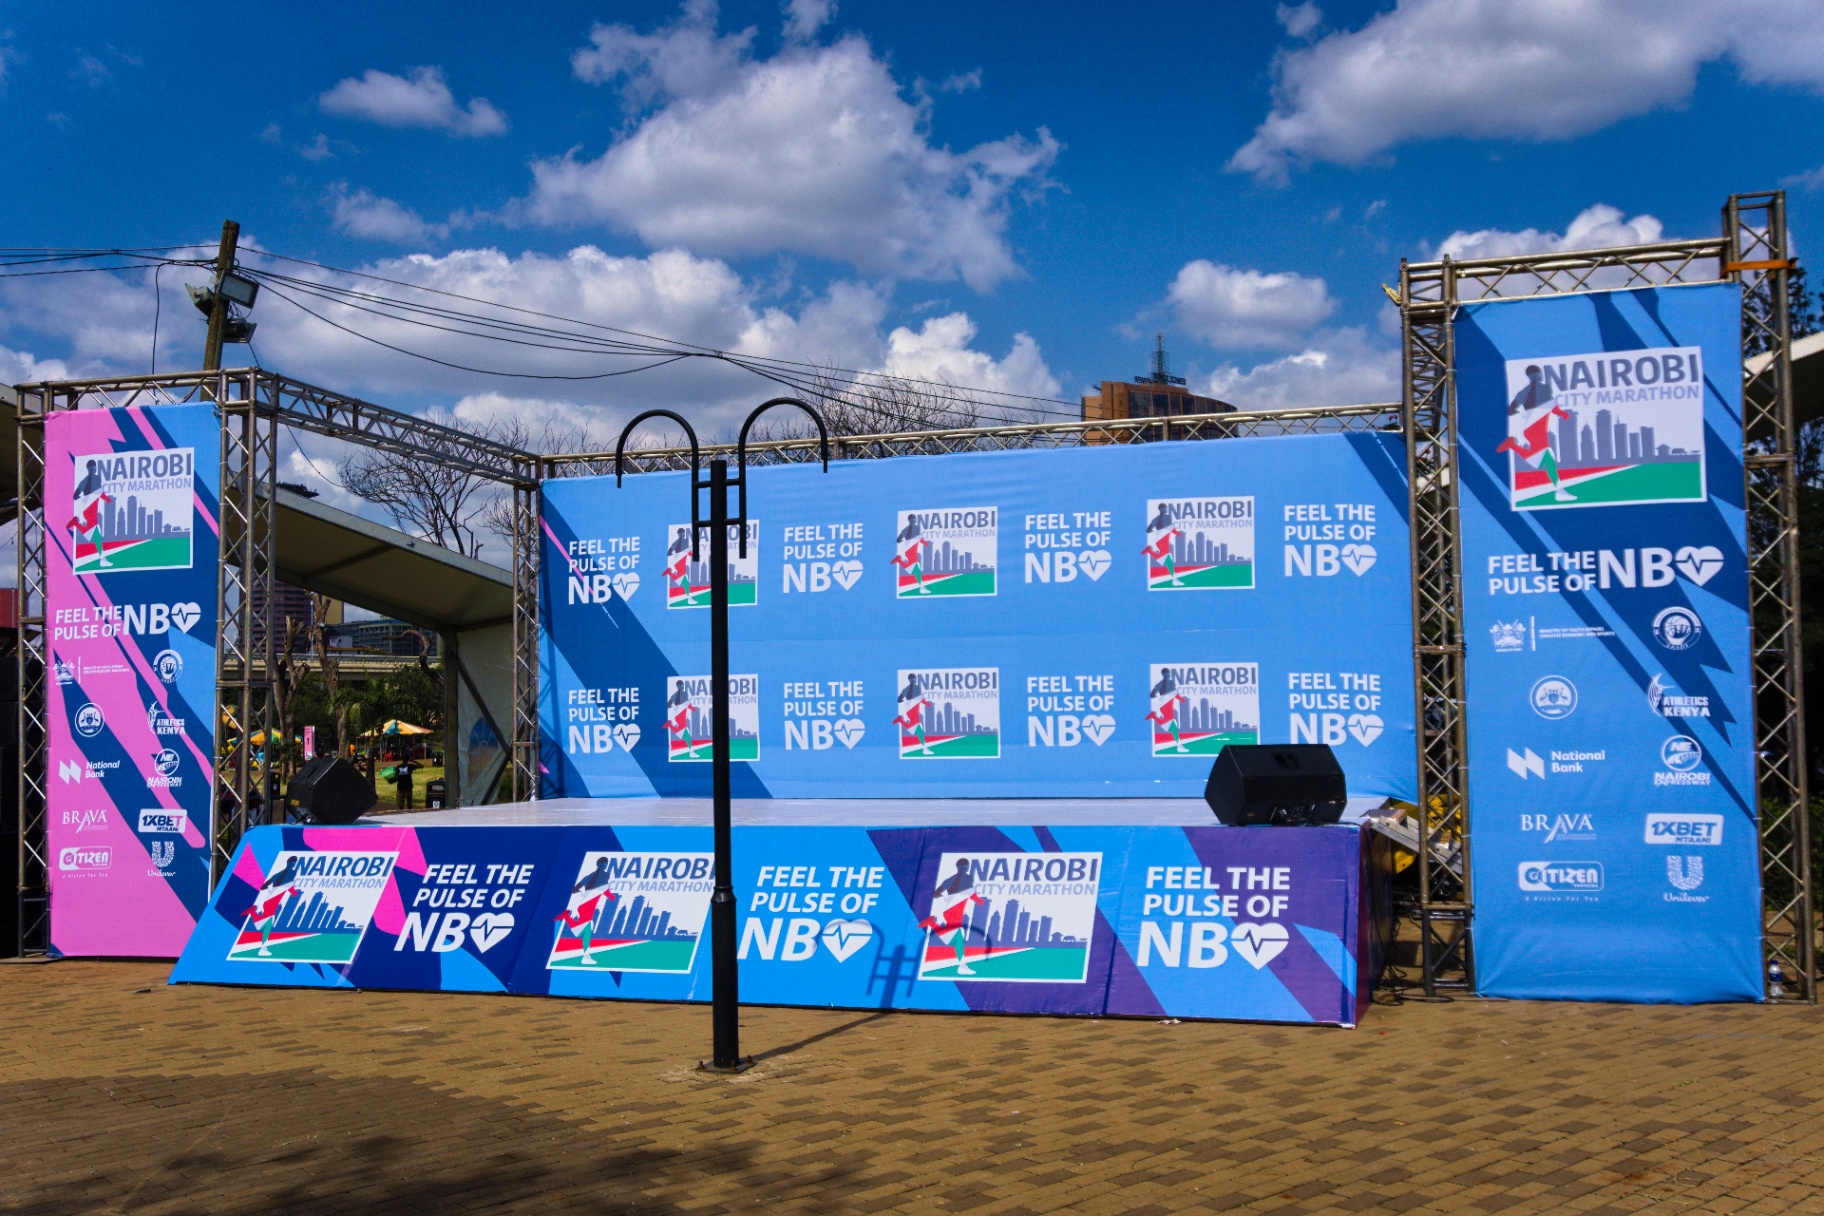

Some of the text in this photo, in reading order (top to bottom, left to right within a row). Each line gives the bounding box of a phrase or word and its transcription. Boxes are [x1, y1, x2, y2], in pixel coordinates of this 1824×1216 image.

[1543, 354, 1698, 392] NAIROBI
[1555, 385, 1700, 408] CITY MARATHON
[97, 453, 192, 481] NAIROBI
[103, 478, 192, 493] CITY MARATHON
[1167, 501, 1252, 520] NAIROBI
[1284, 504, 1376, 522] FEEL THE
[917, 511, 996, 529] NAIROBI
[1026, 512, 1111, 530] FEEL THE
[1172, 520, 1252, 530] CITY MARATHON
[686, 524, 757, 542] NAOI
[784, 523, 863, 542] FEEL THE
[922, 528, 996, 539] CITY MARATHON
[1026, 532, 1111, 548] PULSE OF
[1284, 525, 1376, 541] PULSE OF
[568, 536, 640, 556] FEEL THE
[784, 542, 863, 560] PULSE OF
[570, 555, 640, 572] PULSE OF
[1488, 551, 1596, 574] FEEL THE
[1489, 572, 1596, 596] PULSE OF
[56, 606, 122, 624] FEEL THE
[54, 623, 122, 640] PULSE OF
[917, 672, 997, 690] NAIROBI
[1027, 676, 1114, 693] FEEL THE
[1170, 667, 1256, 685] NAIROBI
[1288, 673, 1381, 692] FEEL THE
[568, 687, 640, 704] FEEL THE
[684, 678, 756, 696] NAIOBI
[784, 681, 864, 698] FEEL THE
[922, 690, 997, 700] CITY MARATHON
[1176, 686, 1256, 695] CITY MARATHON
[784, 700, 864, 716] PULSE OF
[1028, 696, 1114, 712] PULSE OF
[1289, 694, 1381, 710] PULSE OF
[1664, 696, 1708, 706] ATHLETICS
[568, 706, 640, 722] PULSE OF
[1664, 707, 1710, 716] KENYA
[1552, 750, 1606, 761] National
[86, 760, 120, 770] National
[86, 770, 104, 778] Bank
[1552, 762, 1583, 772] Bank
[1655, 772, 1710, 780] NAIROBI
[62, 810, 107, 833] BRAVA
[142, 815, 183, 826] 1XBET
[1520, 814, 1594, 843] BRAVA
[1652, 822, 1717, 836] 1XBET
[295, 856, 395, 877] NAIROBI
[422, 864, 534, 884] FEEL THE
[606, 857, 716, 880] NAIROBI
[968, 858, 1098, 882] NAIROBI
[294, 878, 385, 888] CITY MARATHON
[756, 866, 884, 888] FEEL THE
[1146, 867, 1291, 890] FEEL THE
[608, 881, 714, 892] CITY MARATHON
[974, 883, 1096, 896] CITY MARATHON
[413, 888, 526, 908] PULSE OF
[750, 892, 879, 914] PULSE OF
[1143, 894, 1288, 917] PULSE OF
